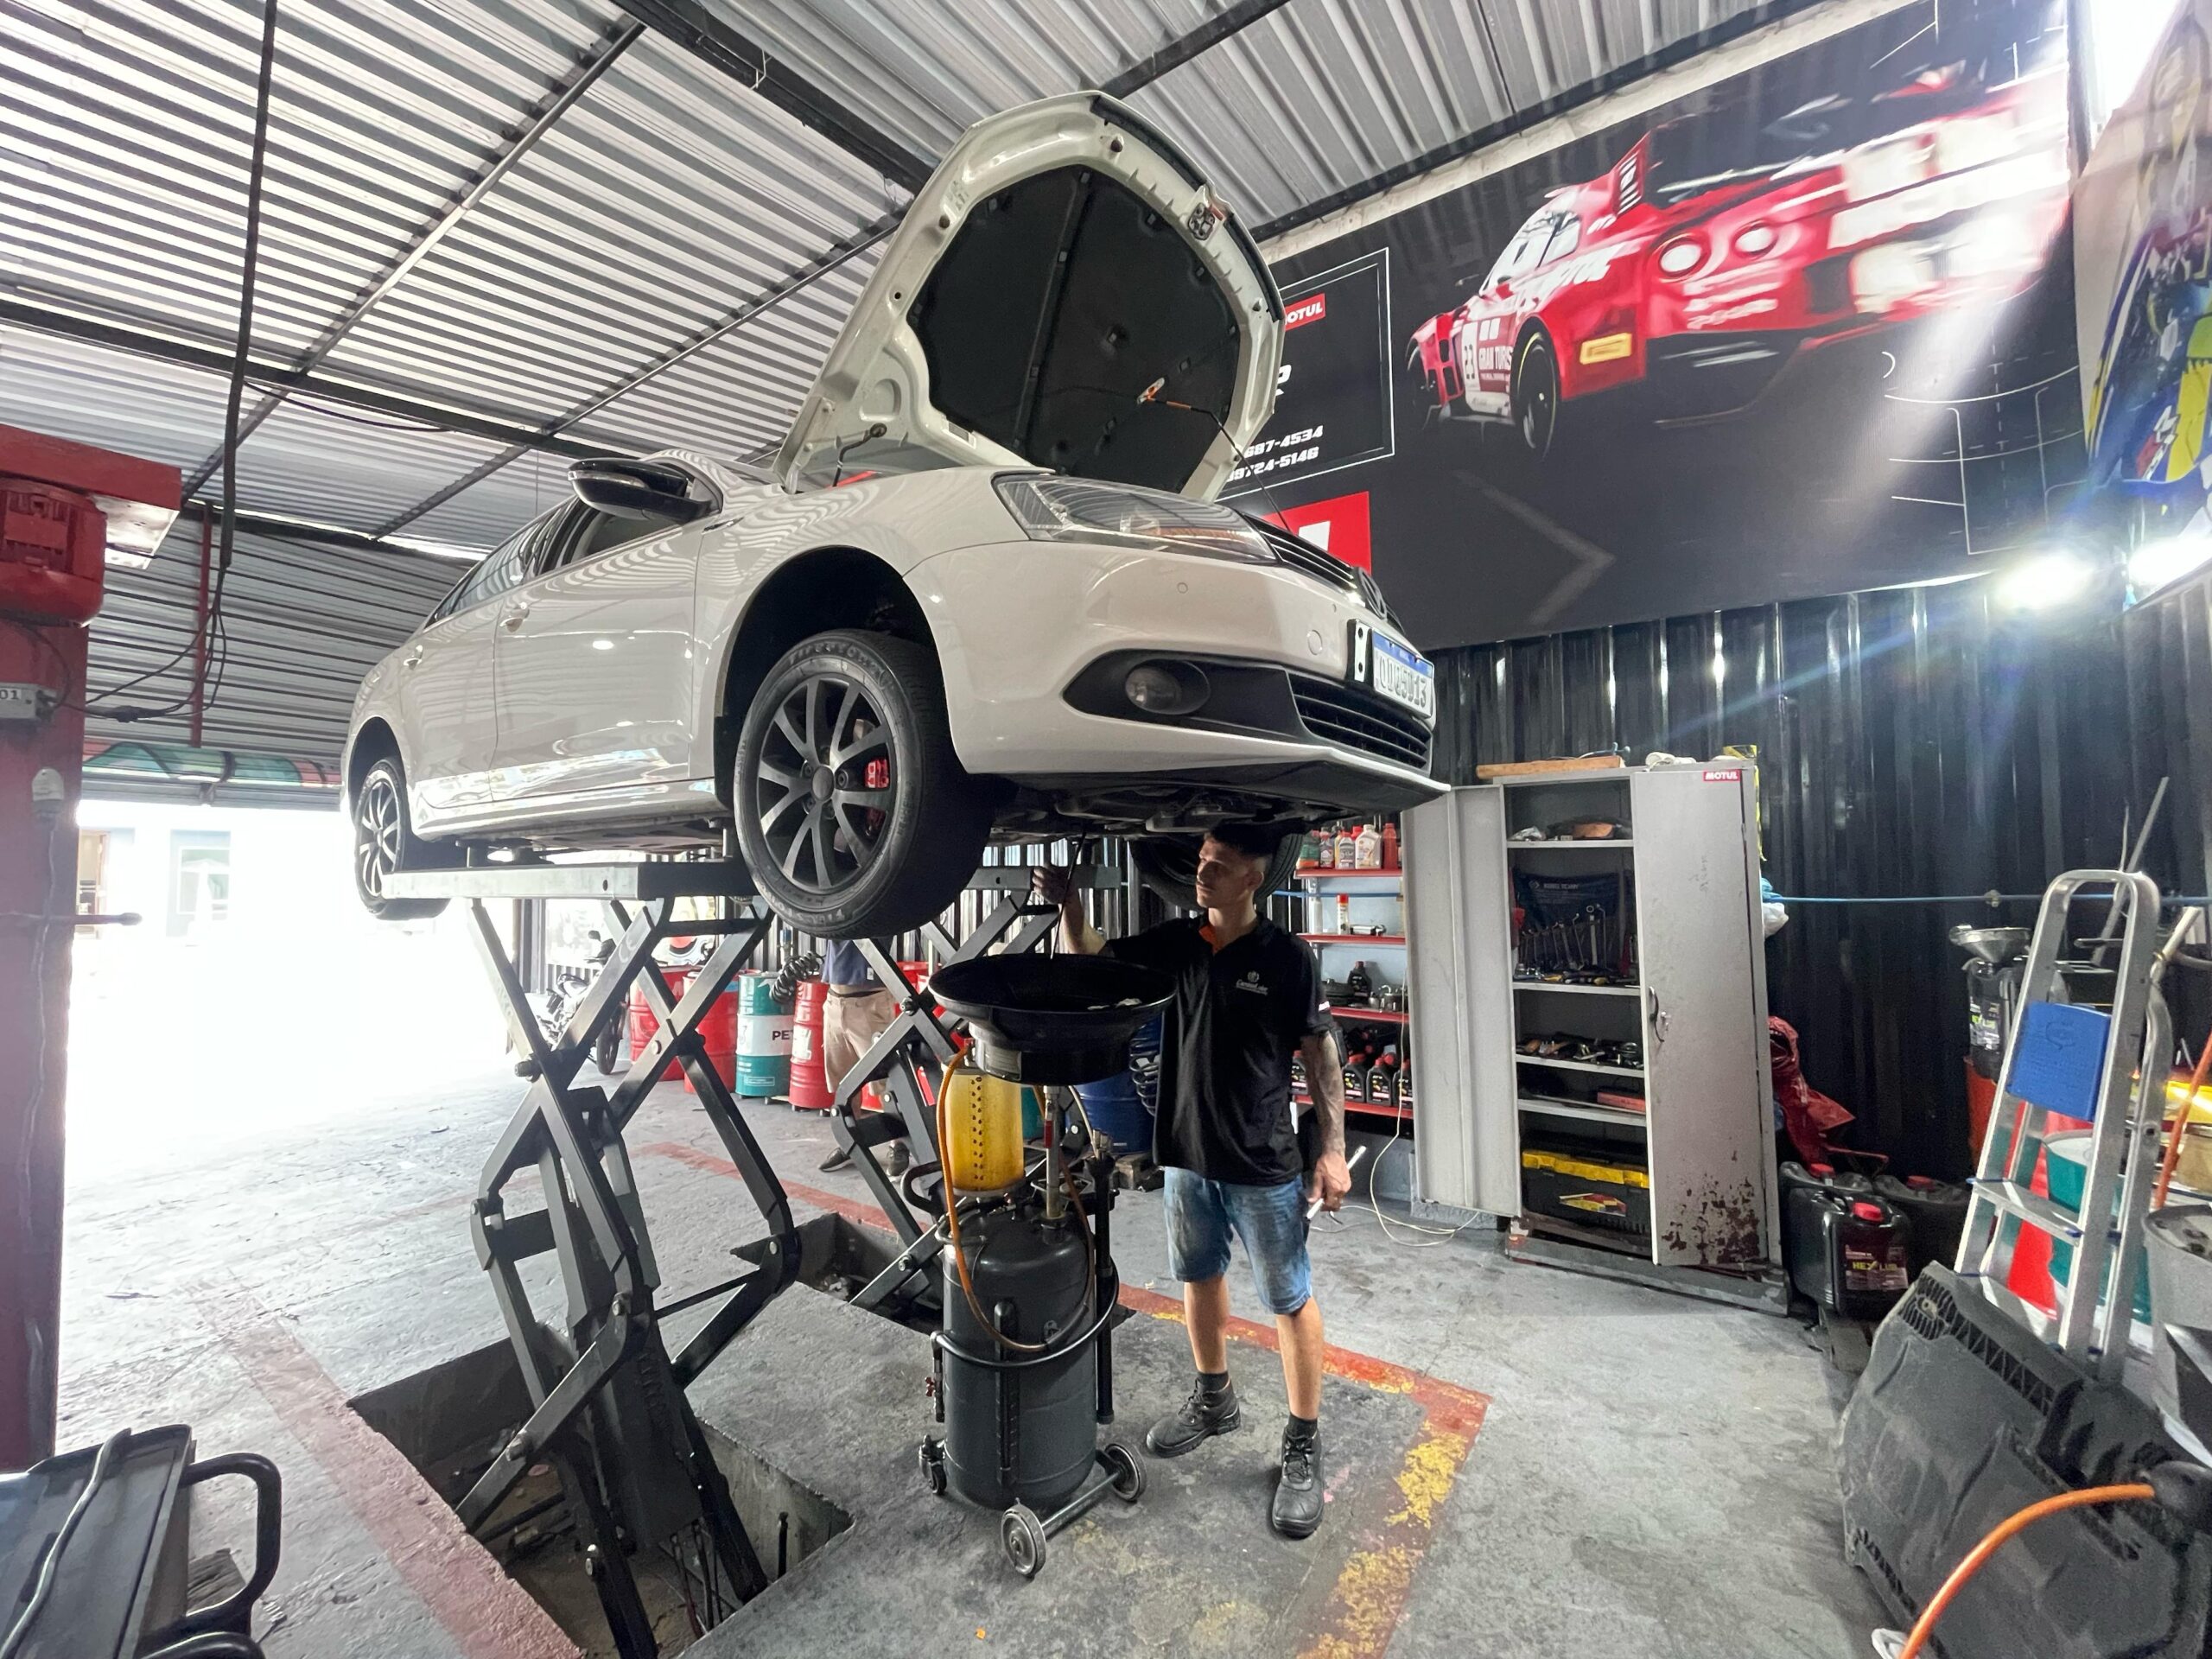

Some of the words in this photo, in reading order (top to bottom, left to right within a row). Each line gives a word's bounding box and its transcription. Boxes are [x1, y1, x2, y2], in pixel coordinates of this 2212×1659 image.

[1285, 302, 1323, 325] OTUL
[1705, 771, 1738, 780] MOTUL
[772, 1030, 793, 1040] PE
